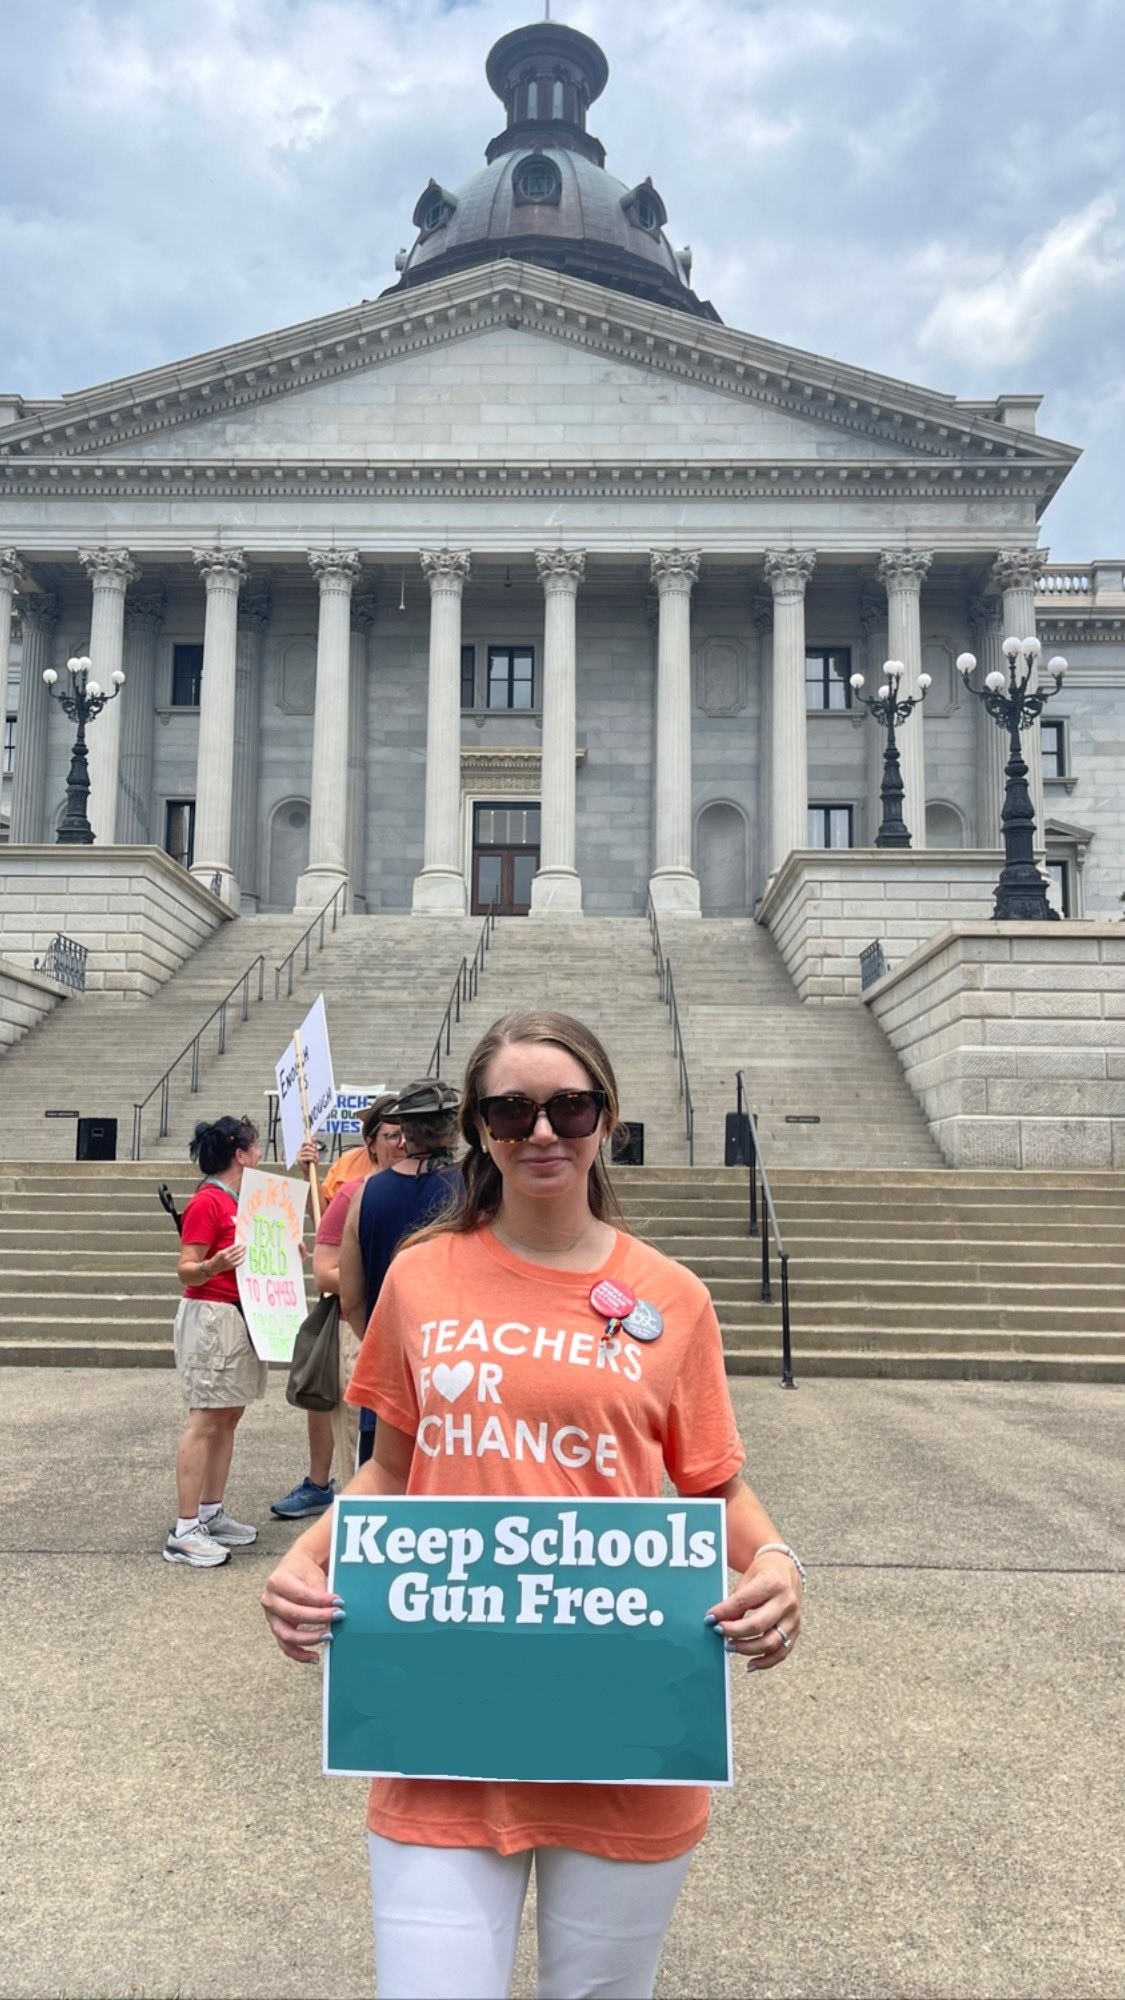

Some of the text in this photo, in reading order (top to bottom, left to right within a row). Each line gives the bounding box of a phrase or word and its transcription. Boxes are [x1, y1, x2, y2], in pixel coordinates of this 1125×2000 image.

[333, 1095, 368, 1108] RCH
[341, 1109, 358, 1119] OU
[253, 1214, 286, 1247] TEXT
[249, 1244, 288, 1275] BOLD
[245, 1278, 260, 1303] TO
[420, 1319, 643, 1382] TEACHERS
[417, 1413, 619, 1478] CHANGE
[340, 1511, 717, 1581] Keep Schools
[388, 1572, 664, 1627] Gun Free.
